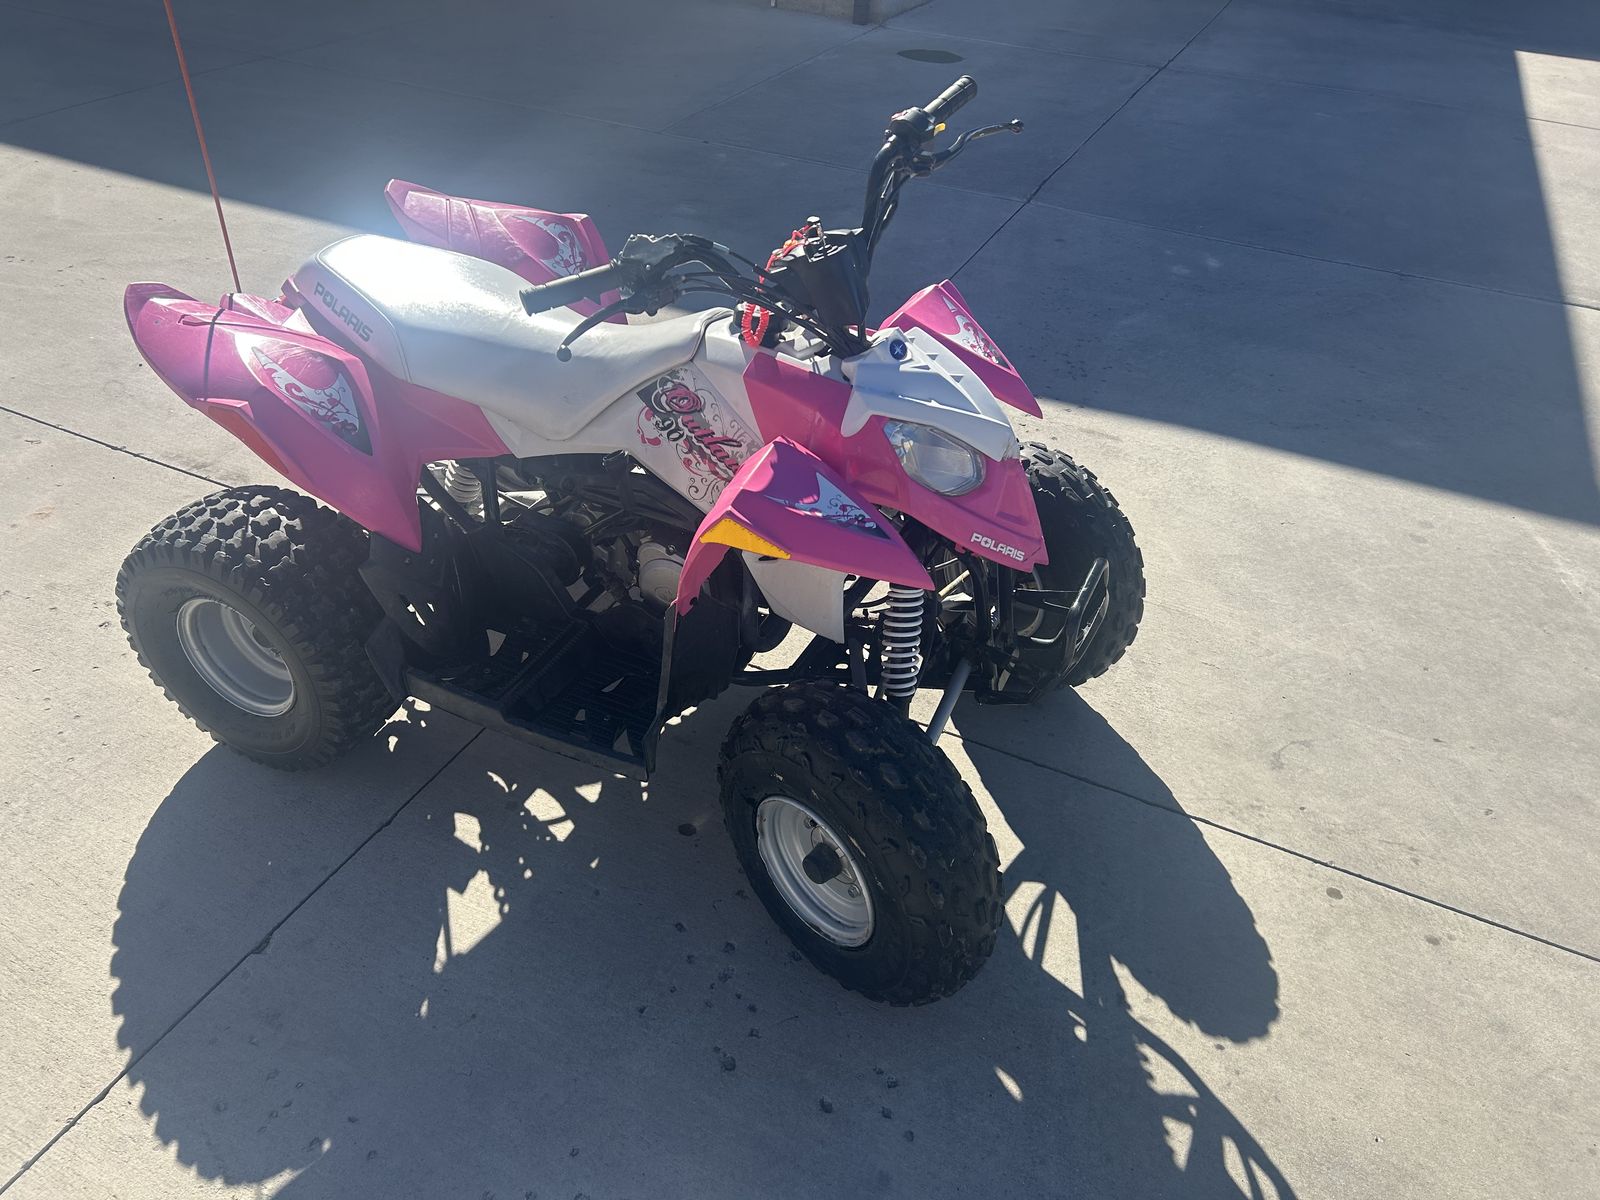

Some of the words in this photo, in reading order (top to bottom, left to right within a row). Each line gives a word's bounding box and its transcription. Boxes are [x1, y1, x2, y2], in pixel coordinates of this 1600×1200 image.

[313, 281, 373, 342] POLARIS
[655, 418, 686, 442] 90
[970, 532, 1025, 562] POLARIS
